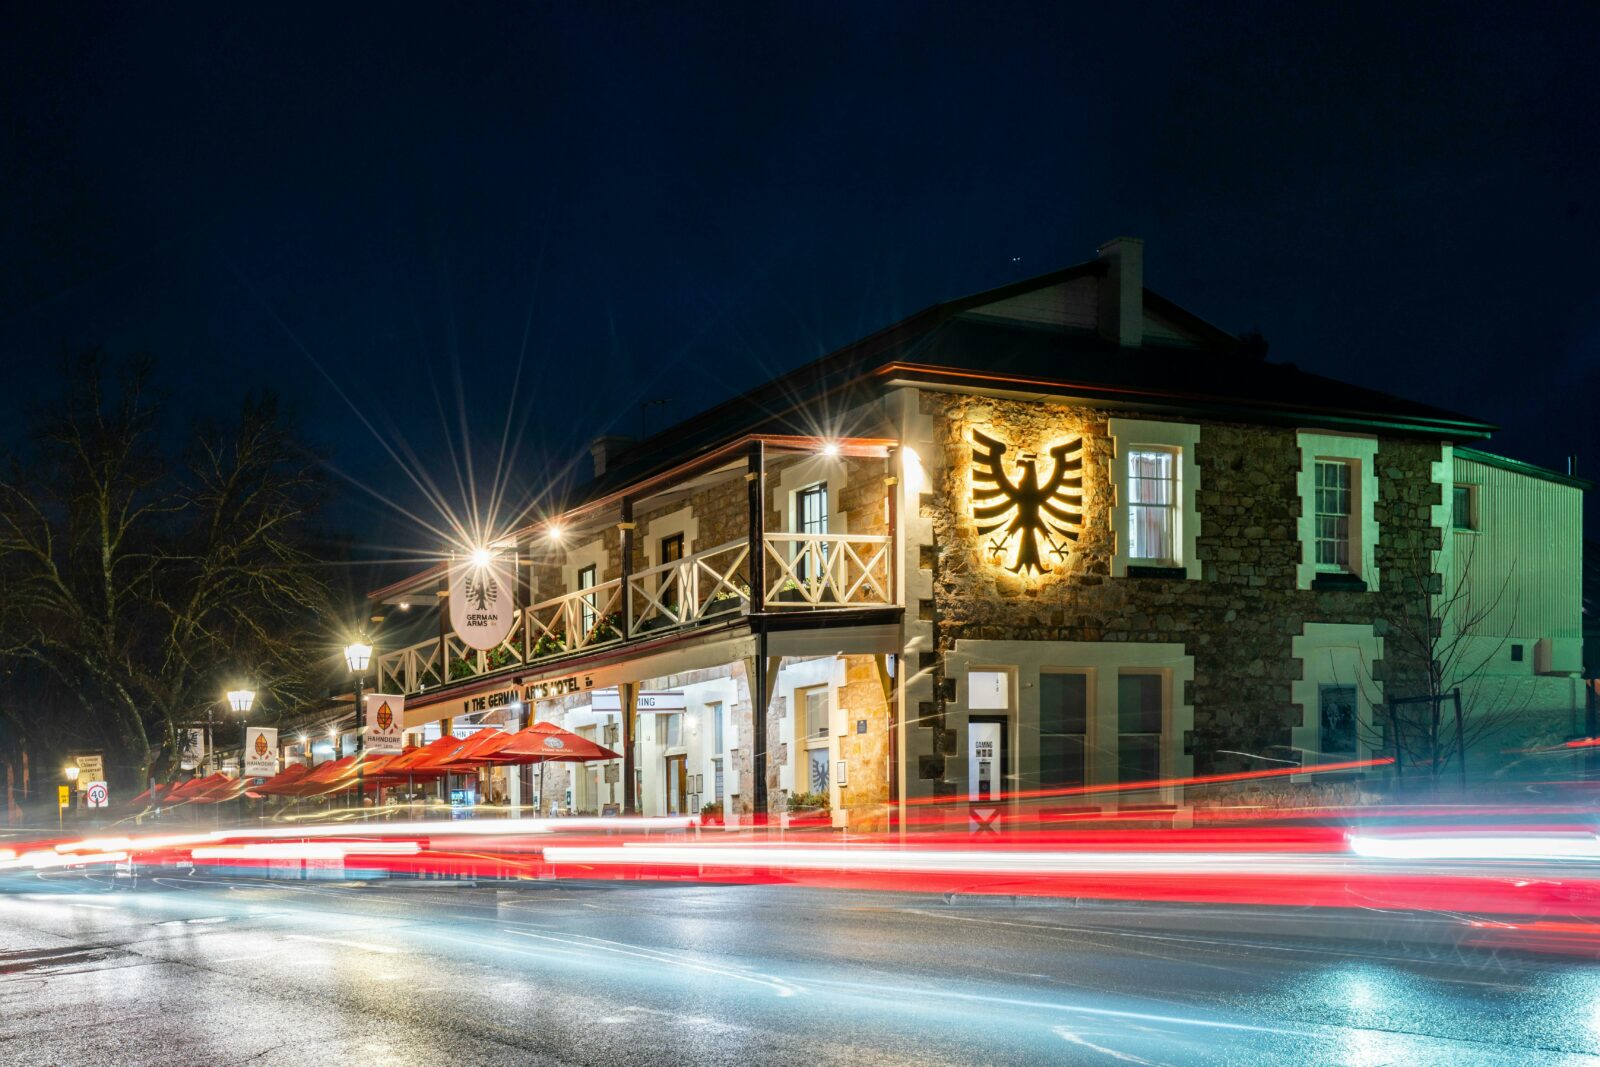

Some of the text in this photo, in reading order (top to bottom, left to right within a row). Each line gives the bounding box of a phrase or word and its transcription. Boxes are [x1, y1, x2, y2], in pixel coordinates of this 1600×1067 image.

[472, 696, 485, 710] THE
[488, 690, 520, 708] GERMAN
[525, 682, 548, 700] ARMS
[551, 677, 580, 696] HOTEL
